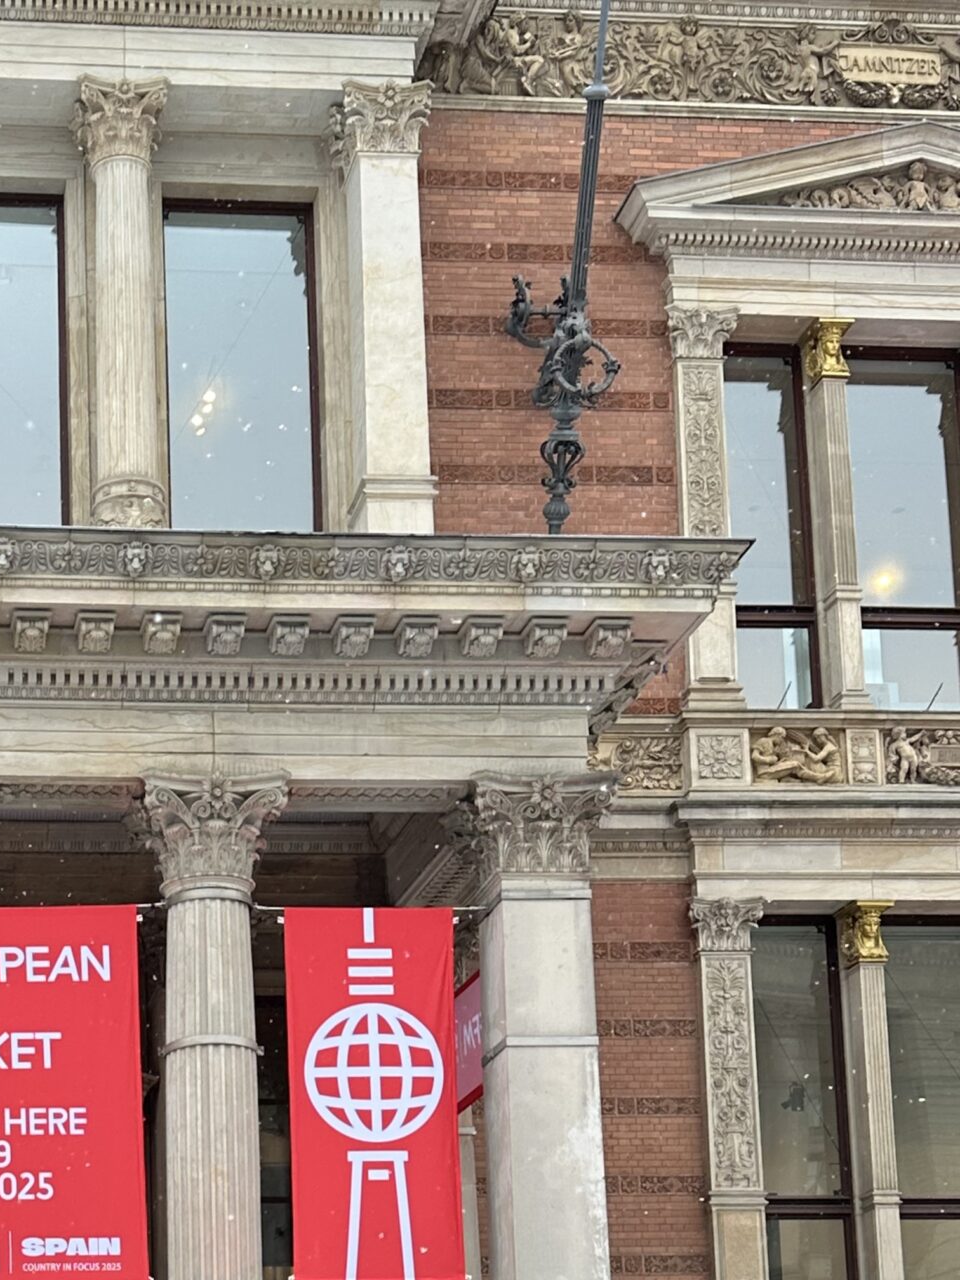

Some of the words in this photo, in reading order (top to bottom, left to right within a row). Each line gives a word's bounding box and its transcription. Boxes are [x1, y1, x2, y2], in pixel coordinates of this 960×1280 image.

[839, 54, 940, 77] JAMNITZER
[4, 1107, 87, 1135] HERE
[21, 1237, 121, 1257] SPAIN
[22, 1263, 60, 1273] COUNTRY
[62, 1263, 71, 1272] IN
[73, 1262, 100, 1272] FOCUS
[101, 1262, 122, 1272] 2025
